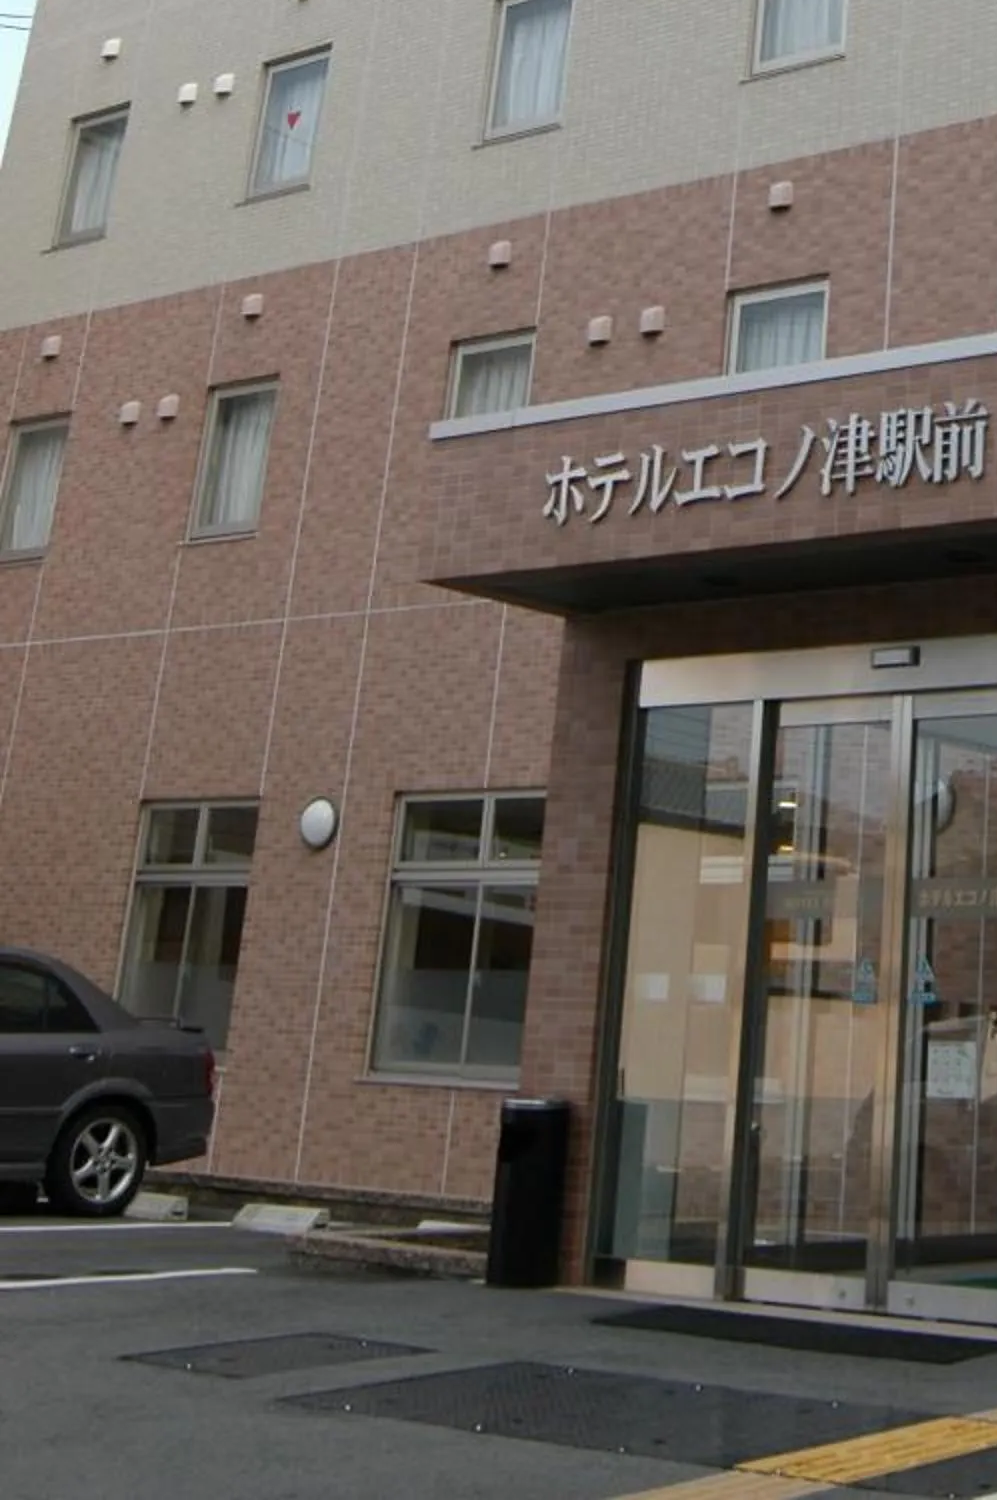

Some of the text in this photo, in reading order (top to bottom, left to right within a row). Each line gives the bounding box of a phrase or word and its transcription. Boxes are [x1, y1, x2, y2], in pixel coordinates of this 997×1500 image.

[543, 398, 989, 526] ホテルエコノ津駅前
